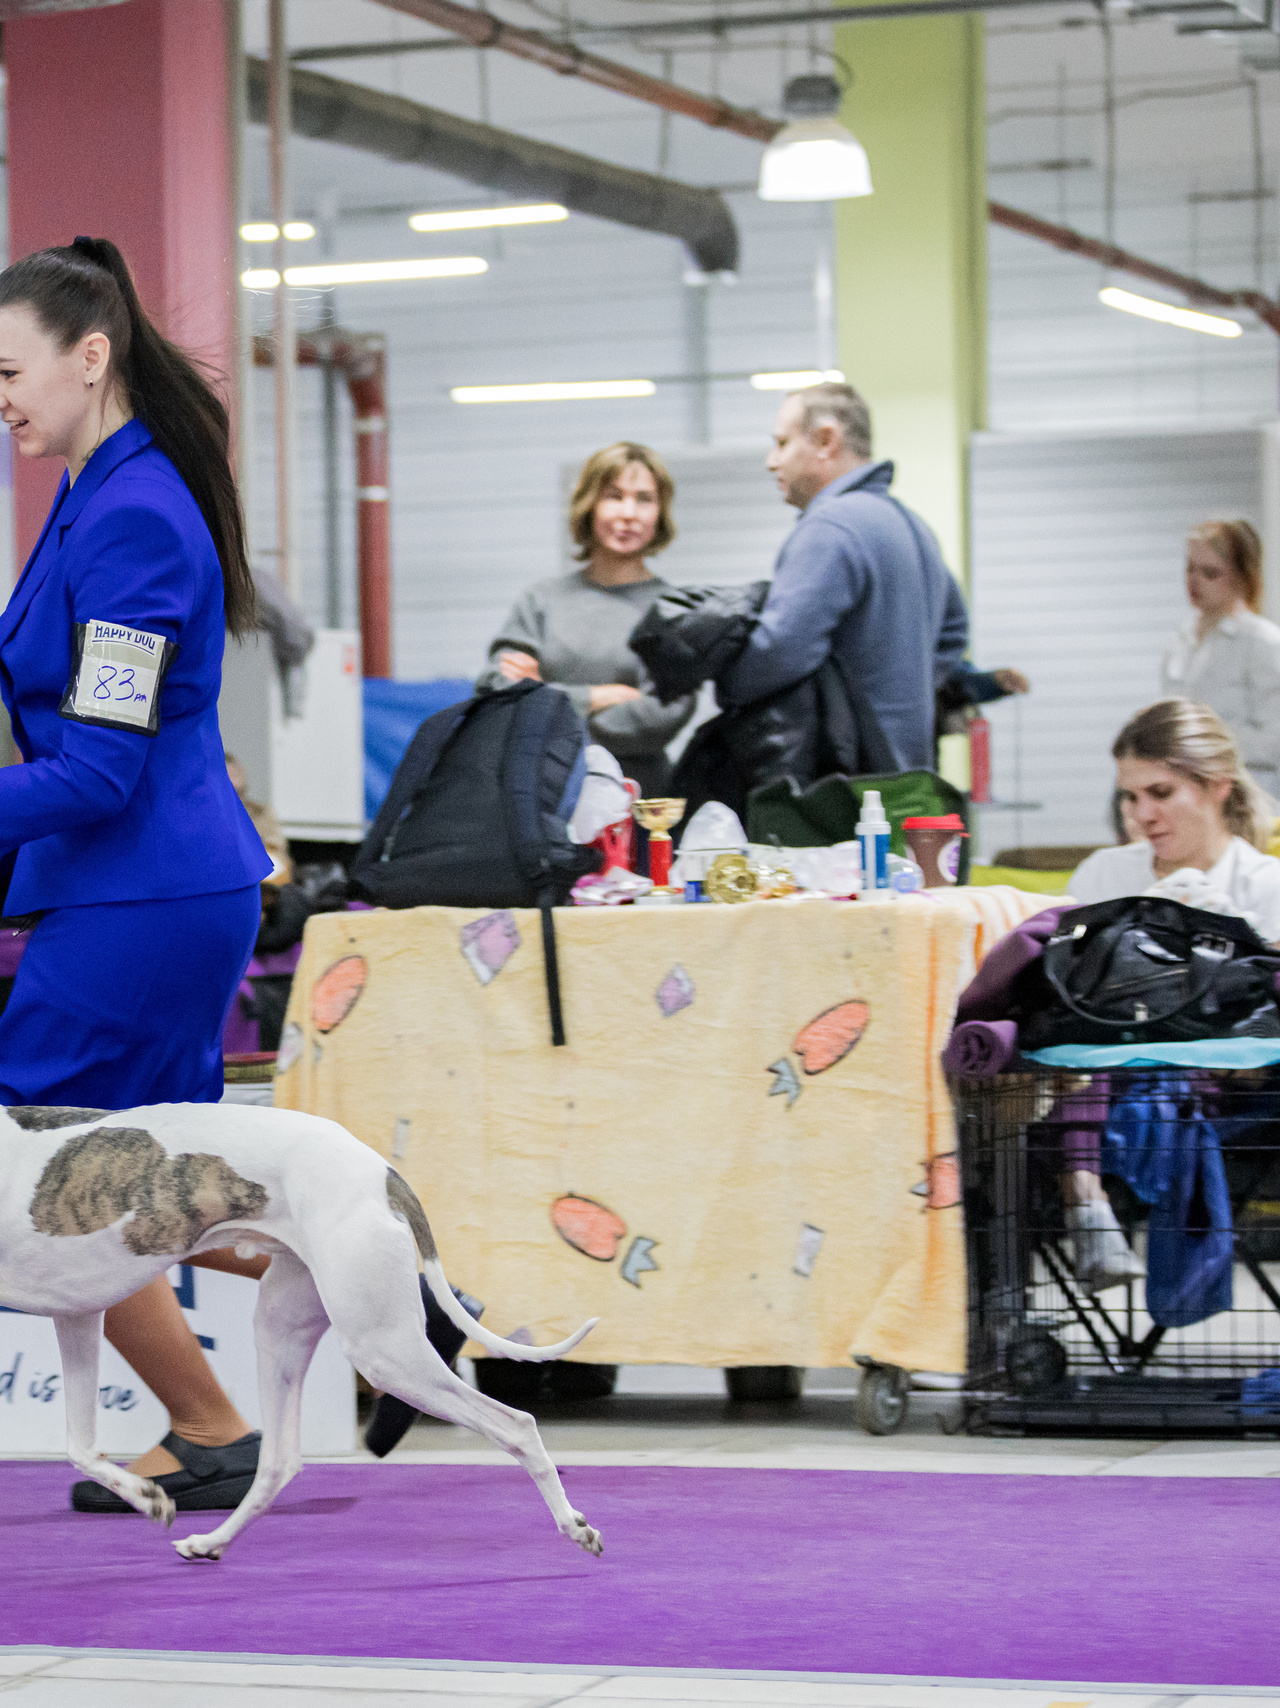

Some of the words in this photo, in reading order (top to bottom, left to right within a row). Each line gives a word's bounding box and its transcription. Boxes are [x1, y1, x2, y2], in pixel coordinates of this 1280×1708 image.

[94, 625, 132, 640] HAPPY
[94, 665, 135, 701] 83
[29, 1371, 61, 1402] is
